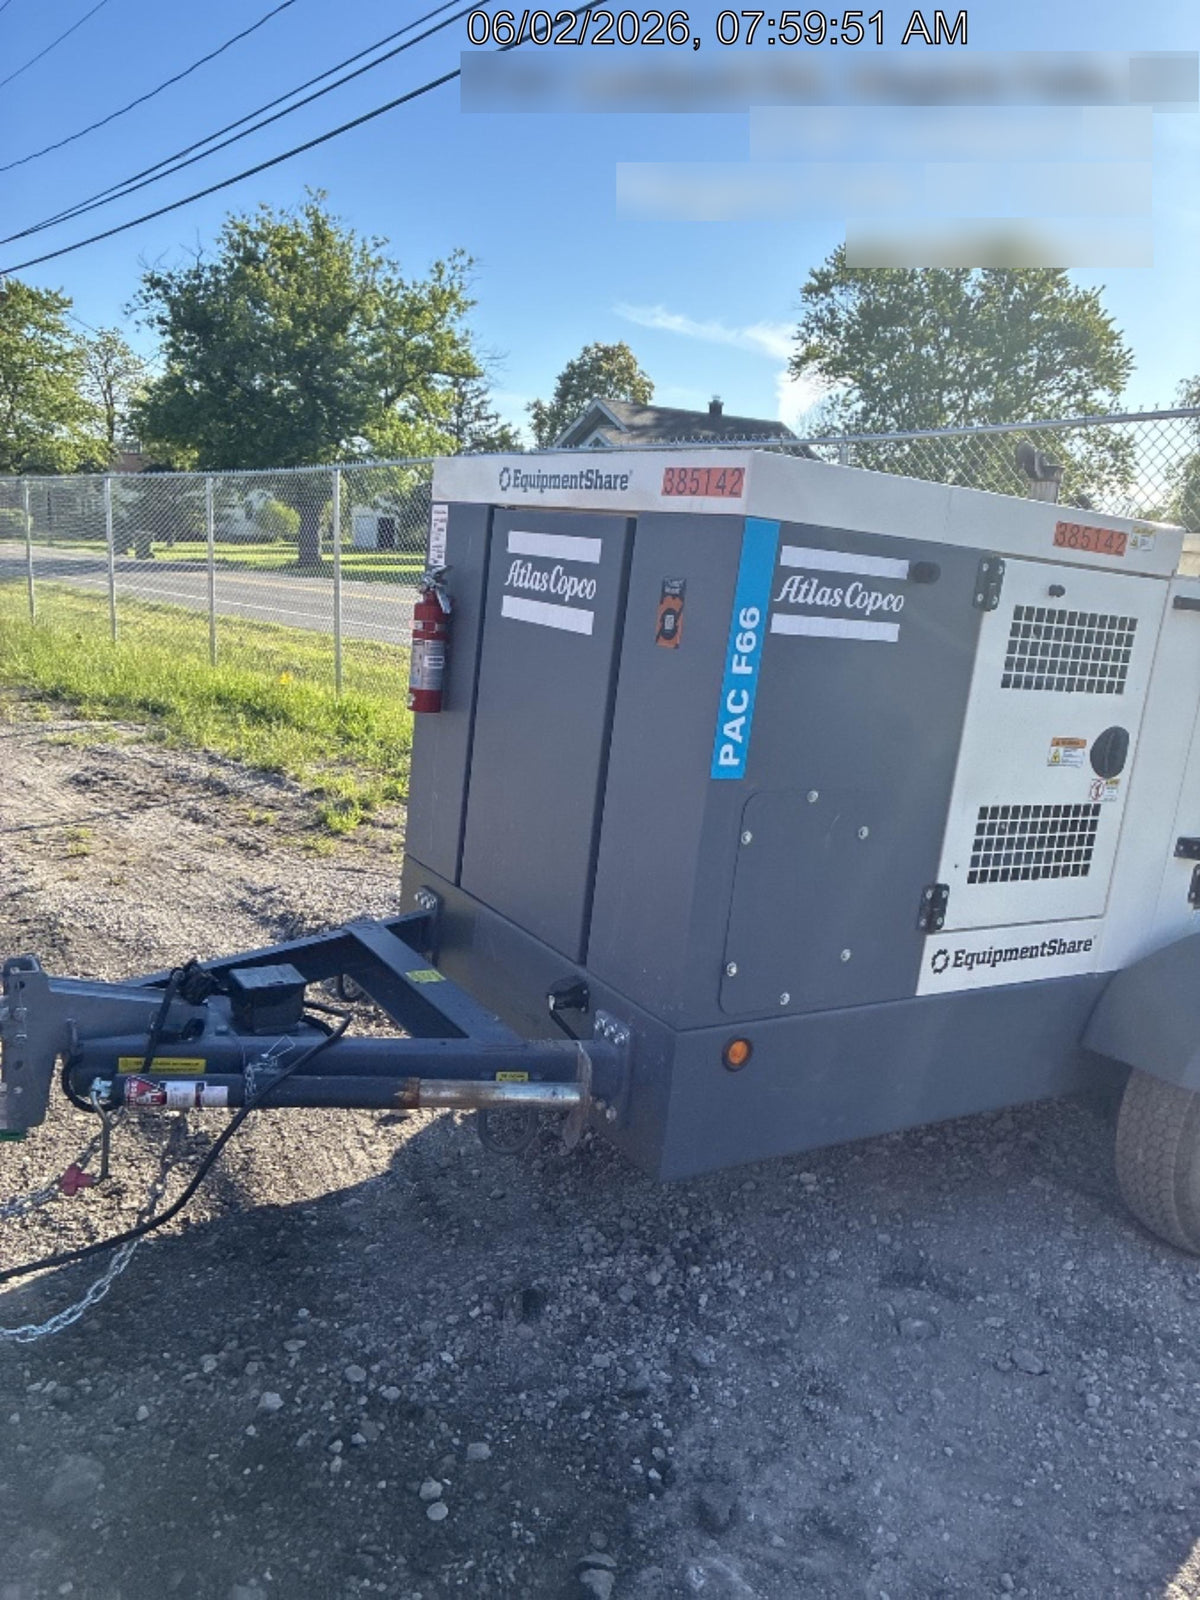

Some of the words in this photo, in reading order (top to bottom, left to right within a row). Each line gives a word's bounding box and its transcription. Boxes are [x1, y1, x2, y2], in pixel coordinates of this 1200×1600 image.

[512, 469, 630, 493] EquipmentShare
[663, 467, 743, 497] 385142
[1054, 522, 1128, 557] 385142
[731, 606, 761, 675] F66
[718, 689, 750, 766] PAC
[952, 938, 1093, 971] EquipmentShare
